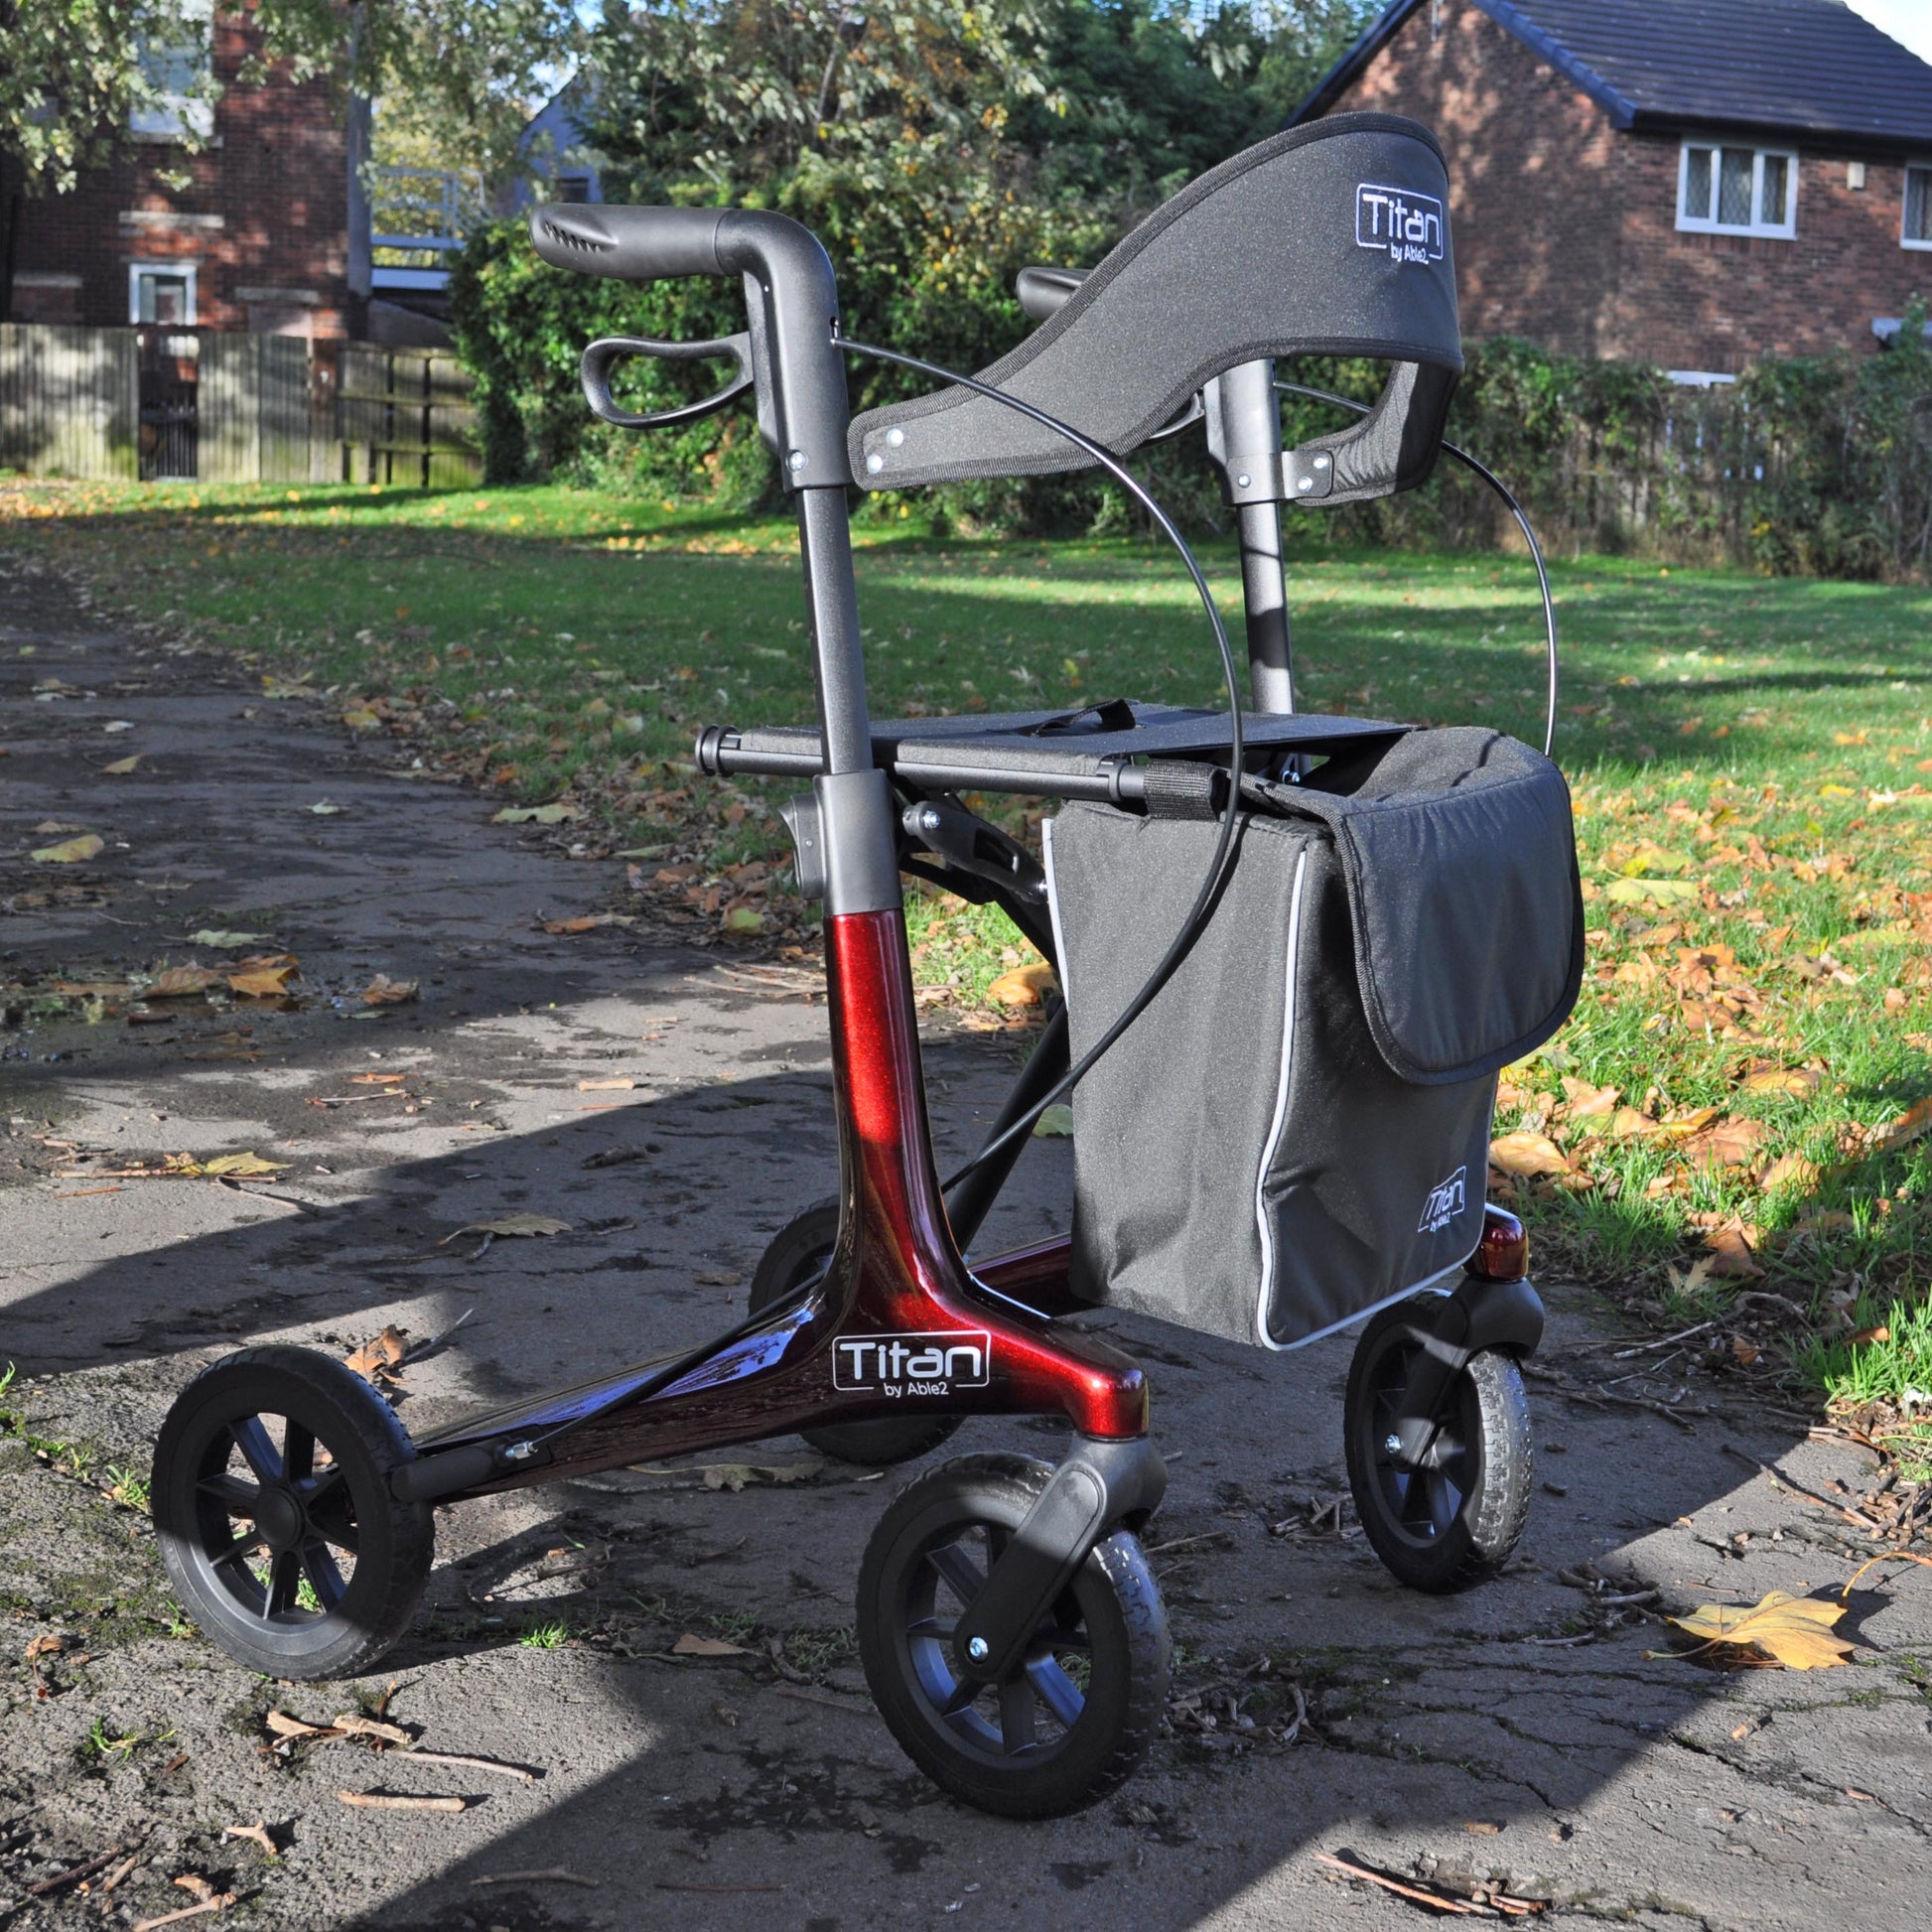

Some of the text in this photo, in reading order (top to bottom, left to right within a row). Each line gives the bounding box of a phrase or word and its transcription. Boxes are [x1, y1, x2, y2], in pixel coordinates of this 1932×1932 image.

[1362, 193, 1440, 246] Titan
[1390, 241, 1429, 264] by Able2
[1426, 1179, 1462, 1220] Titan
[839, 1340, 982, 1380] Titan
[884, 1381, 949, 1398] by Able2
